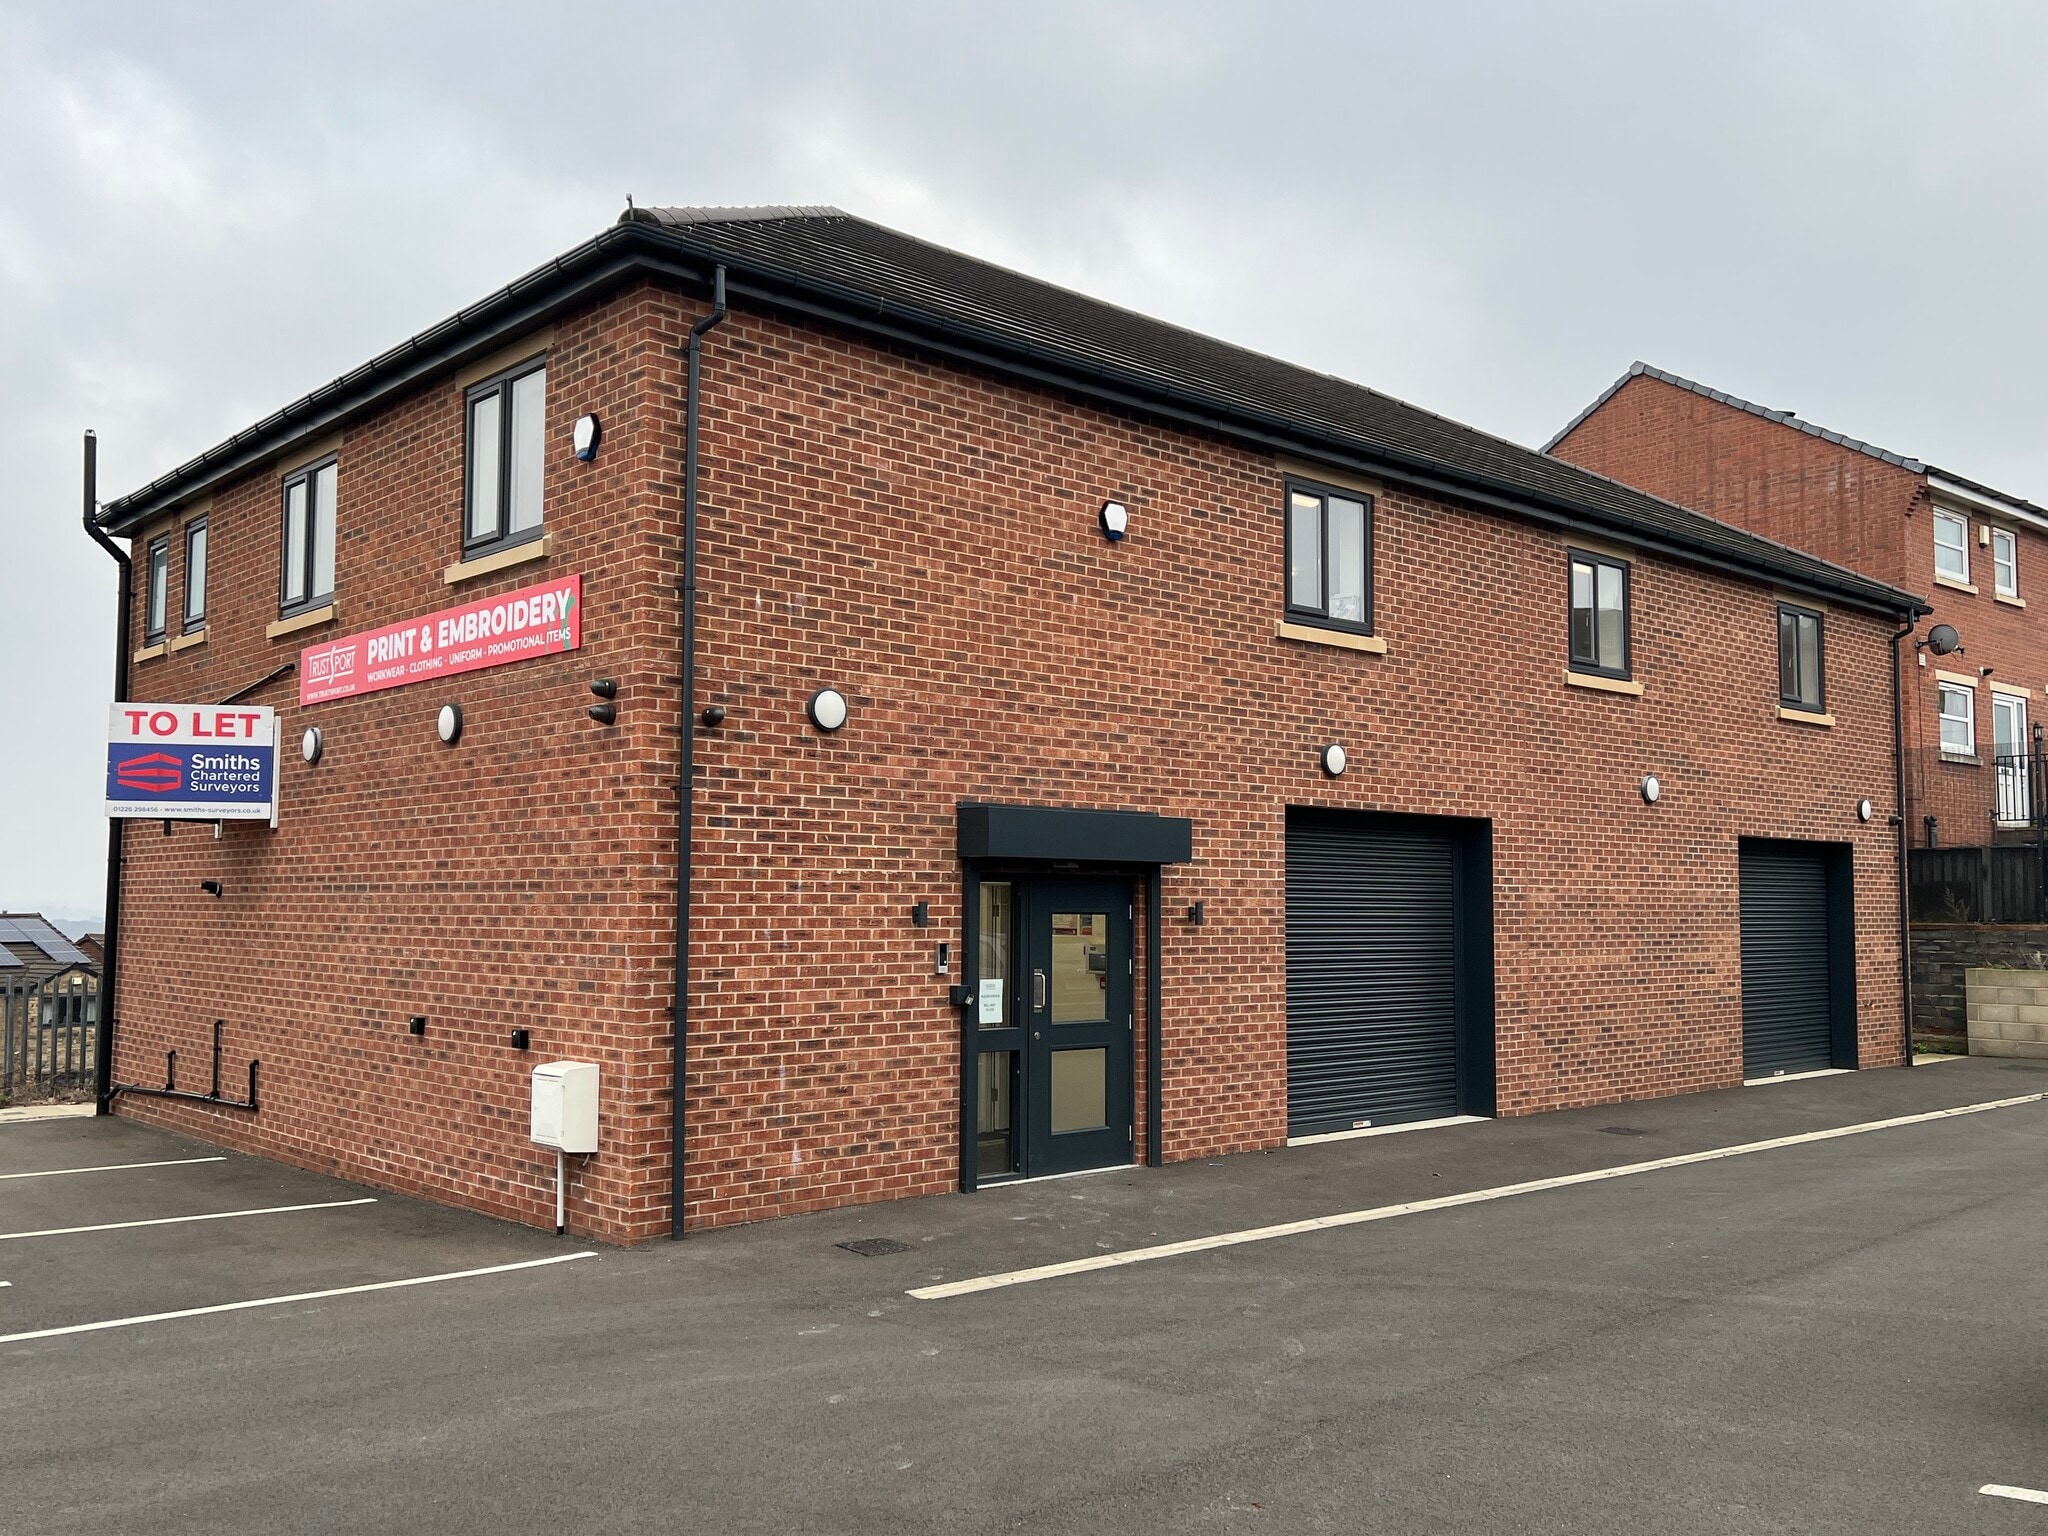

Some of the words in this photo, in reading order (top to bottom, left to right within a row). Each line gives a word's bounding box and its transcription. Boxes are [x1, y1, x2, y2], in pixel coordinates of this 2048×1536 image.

[367, 628, 416, 665] PRINT
[420, 625, 433, 652] &
[438, 588, 571, 648] EMBROIDERY
[367, 666, 405, 683] WORKWEAR
[409, 656, 443, 673] CLOTHING
[449, 649, 482, 665] UNIFORM
[488, 635, 545, 657] PROMOTIONAL
[546, 627, 571, 644] ITEMS
[124, 711, 178, 736] TO
[192, 712, 261, 738] LET
[191, 753, 260, 770] Smiths
[190, 770, 260, 782] Chartered
[190, 781, 260, 794] Surveyors
